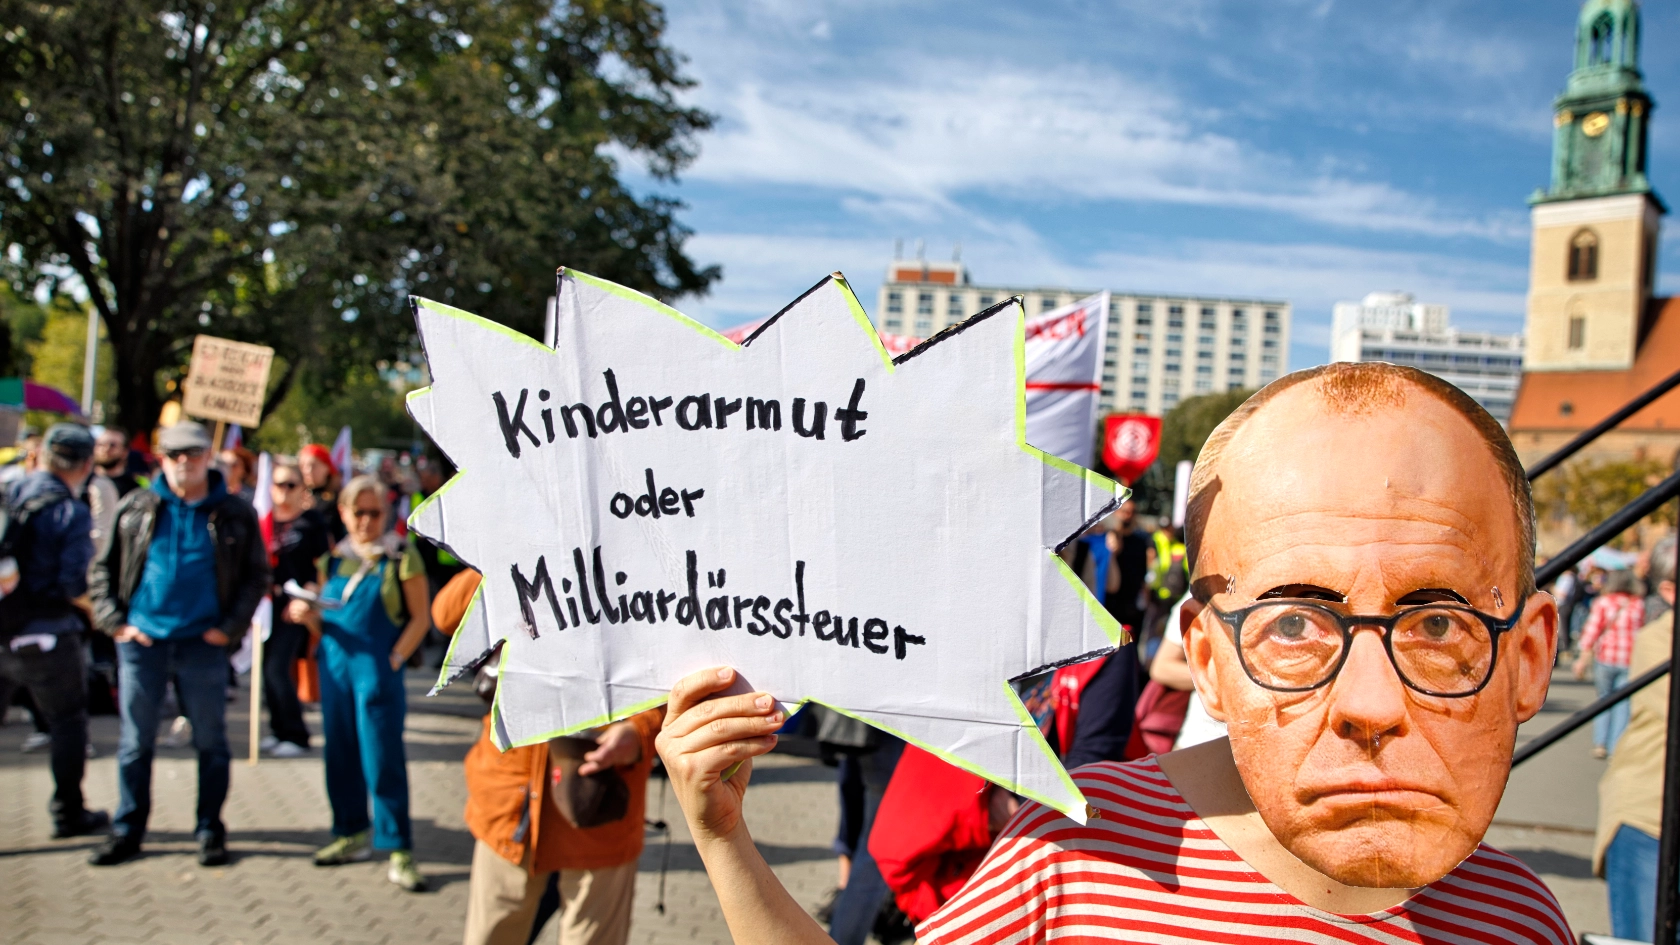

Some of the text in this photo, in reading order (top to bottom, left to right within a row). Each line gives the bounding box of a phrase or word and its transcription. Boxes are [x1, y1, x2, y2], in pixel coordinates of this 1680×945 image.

[491, 367, 869, 459] Kinderarmut
[609, 467, 705, 520] oder
[510, 545, 927, 661] Milliardärssteuer
